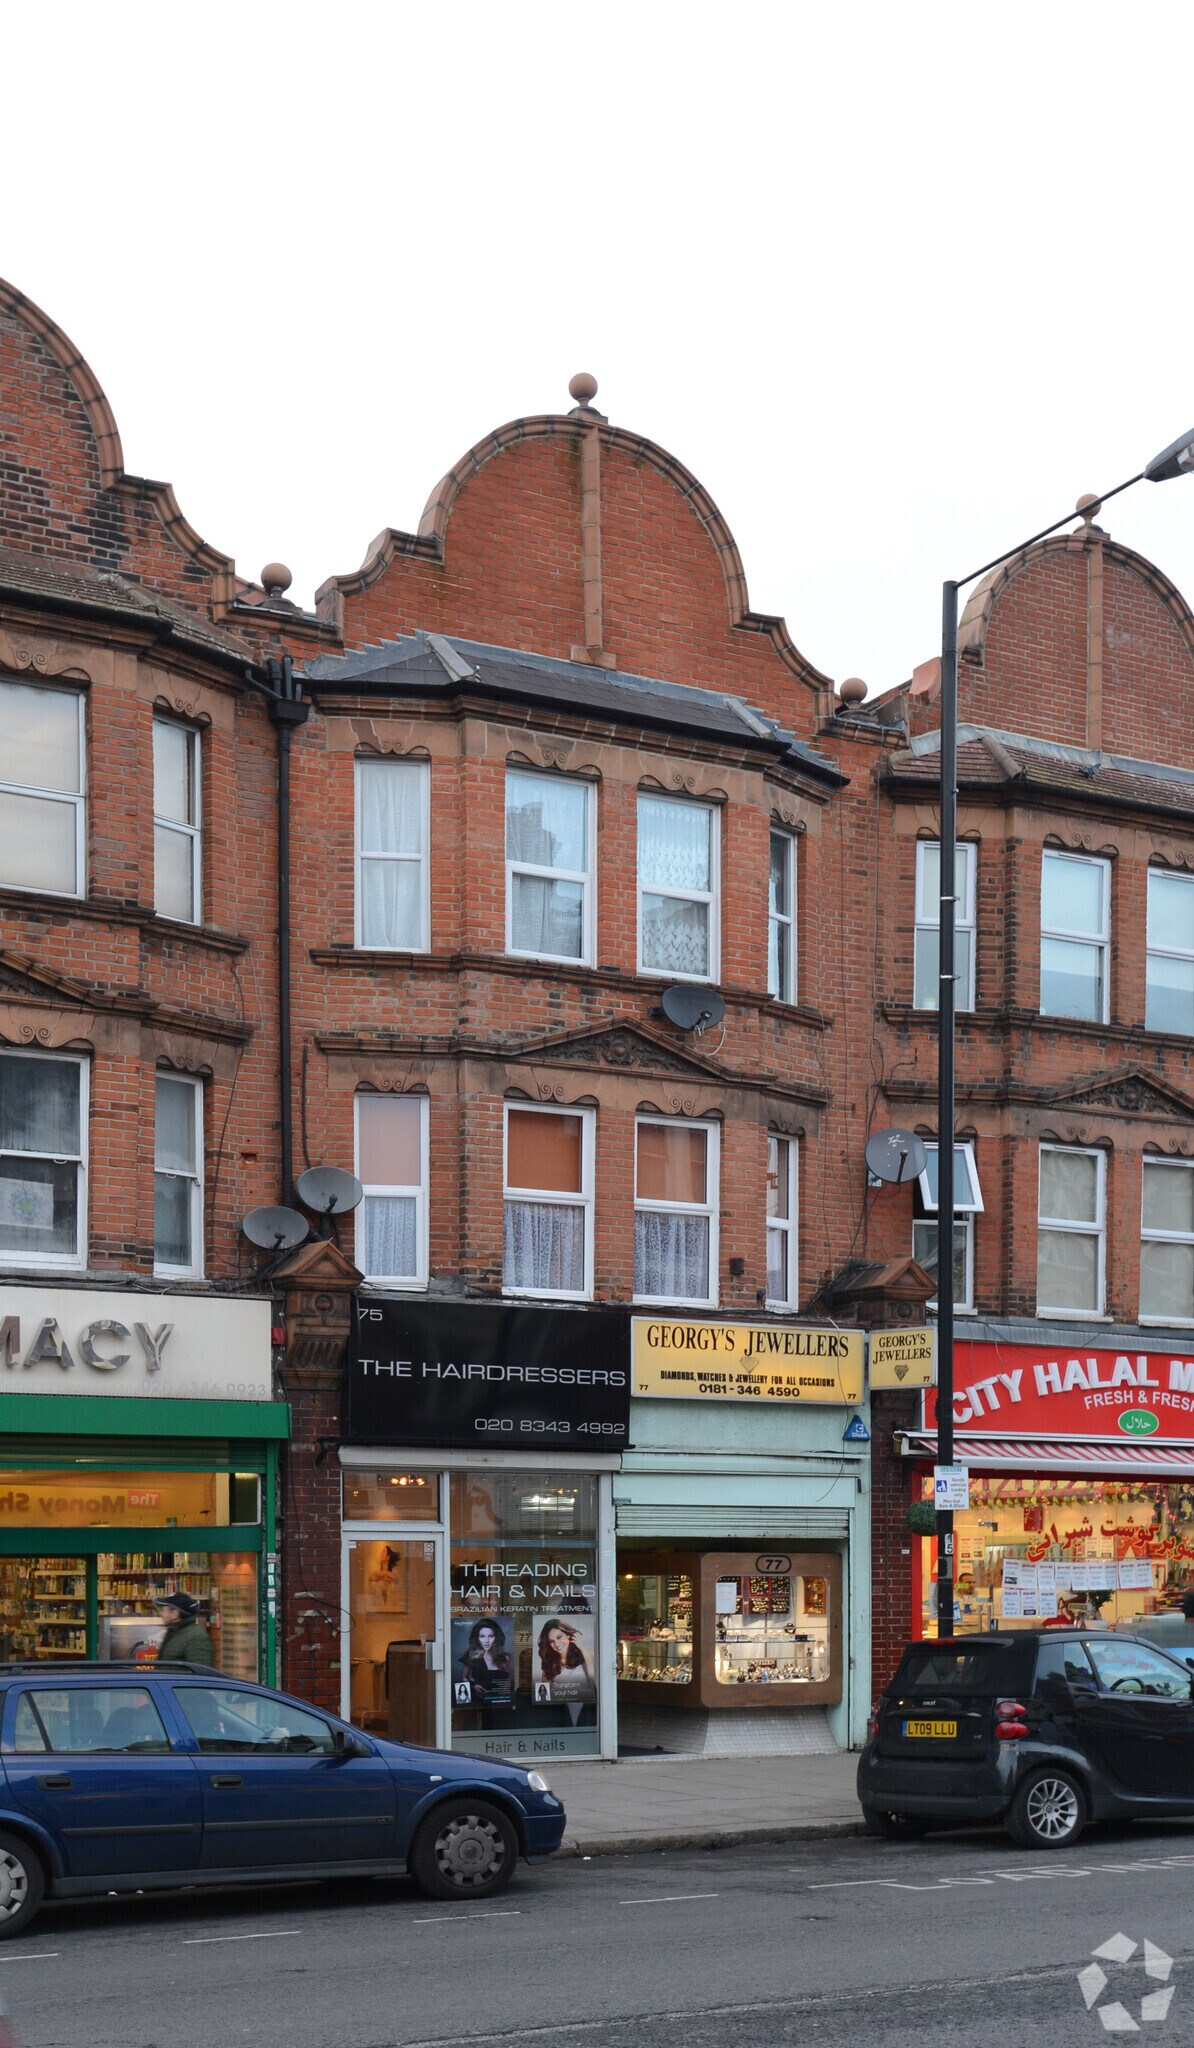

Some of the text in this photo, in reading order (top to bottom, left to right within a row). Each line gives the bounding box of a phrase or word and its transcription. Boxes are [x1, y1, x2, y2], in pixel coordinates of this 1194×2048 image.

[358, 1308, 383, 1321] 75
[647, 1325, 849, 1358] GEORGY'S JEWELLERS
[878, 1333, 926, 1348] GEORGY'S
[872, 1347, 932, 1365] JEWELLERS
[358, 1359, 626, 1387] THE HAIRDRESSERS
[660, 1370, 835, 1388] DIAMONDS, WATCHES & JEWELLERY FOR ALL OCCASIONS
[922, 1375, 931, 1383] 77
[226, 1383, 266, 1397] 0923
[699, 1383, 727, 1394] 0181
[737, 1385, 761, 1396] 346
[767, 1387, 800, 1397] 4590
[952, 1368, 1024, 1424] CITY
[1032, 1355, 1160, 1397] HALAL
[1083, 1389, 1134, 1410] FRESH
[1137, 1389, 1149, 1404] &
[474, 1418, 626, 1435] 020 8343 4992
[1126, 1415, 1152, 1429] حلال
[459, 1563, 588, 1577] THREADING
[765, 1559, 783, 1570] 77
[450, 1584, 596, 1599] HAIR & NAILS
[500, 1605, 539, 1613] KERATIN
[907, 1722, 955, 1736] LT09 LLU
[485, 1739, 566, 1754] Hair & Nails
